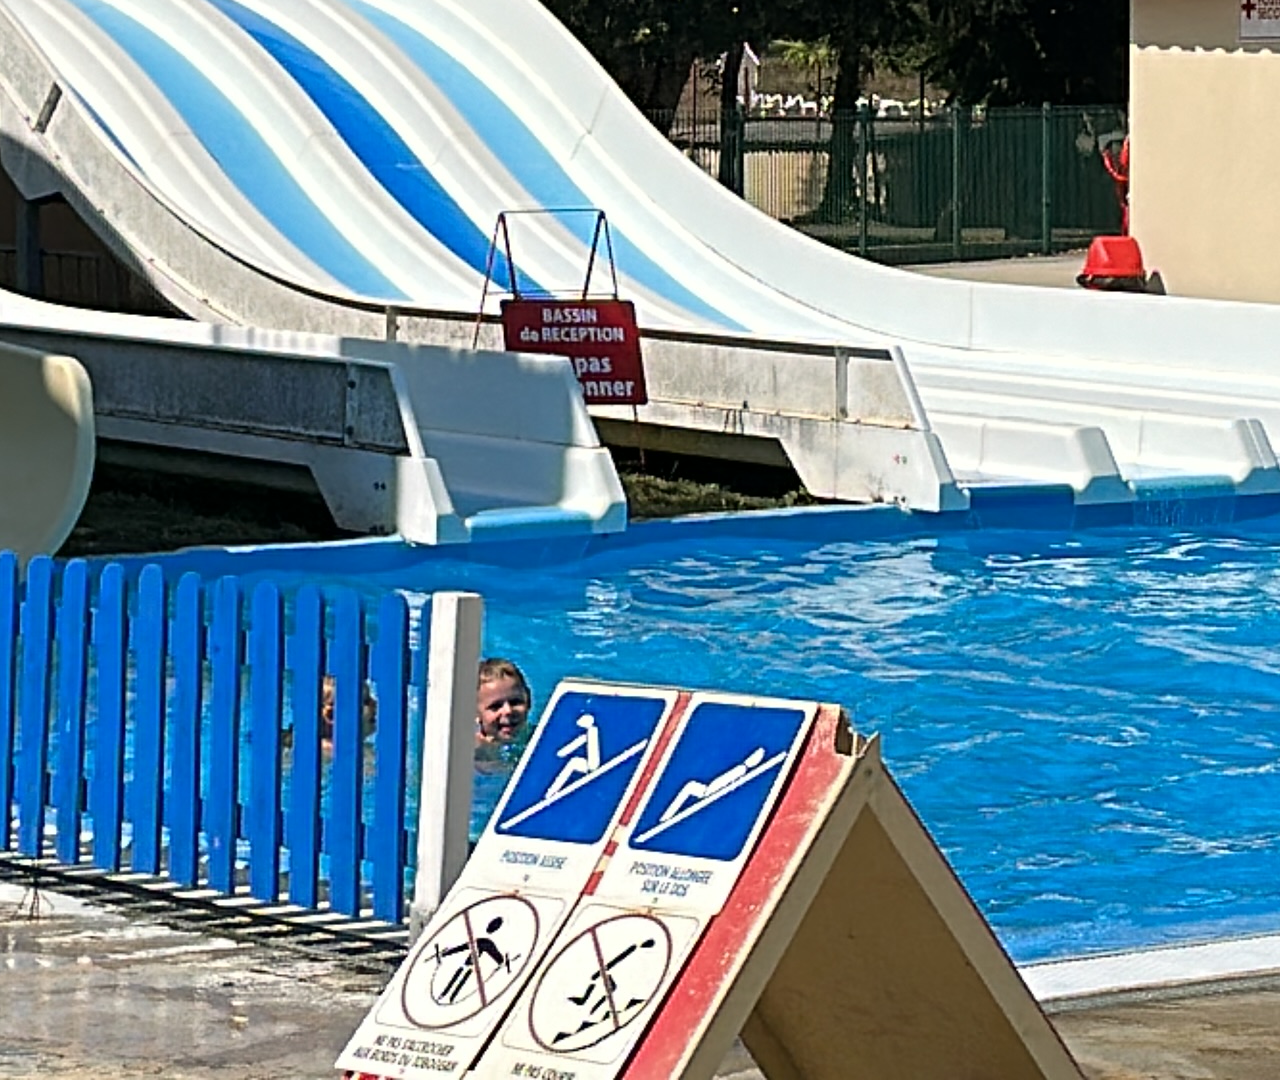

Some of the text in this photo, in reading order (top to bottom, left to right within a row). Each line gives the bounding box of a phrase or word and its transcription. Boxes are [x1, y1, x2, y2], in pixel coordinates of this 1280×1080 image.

[542, 307, 597, 323] BASSIN
[520, 327, 625, 342] de RECEPTION
[574, 356, 613, 376] pas
